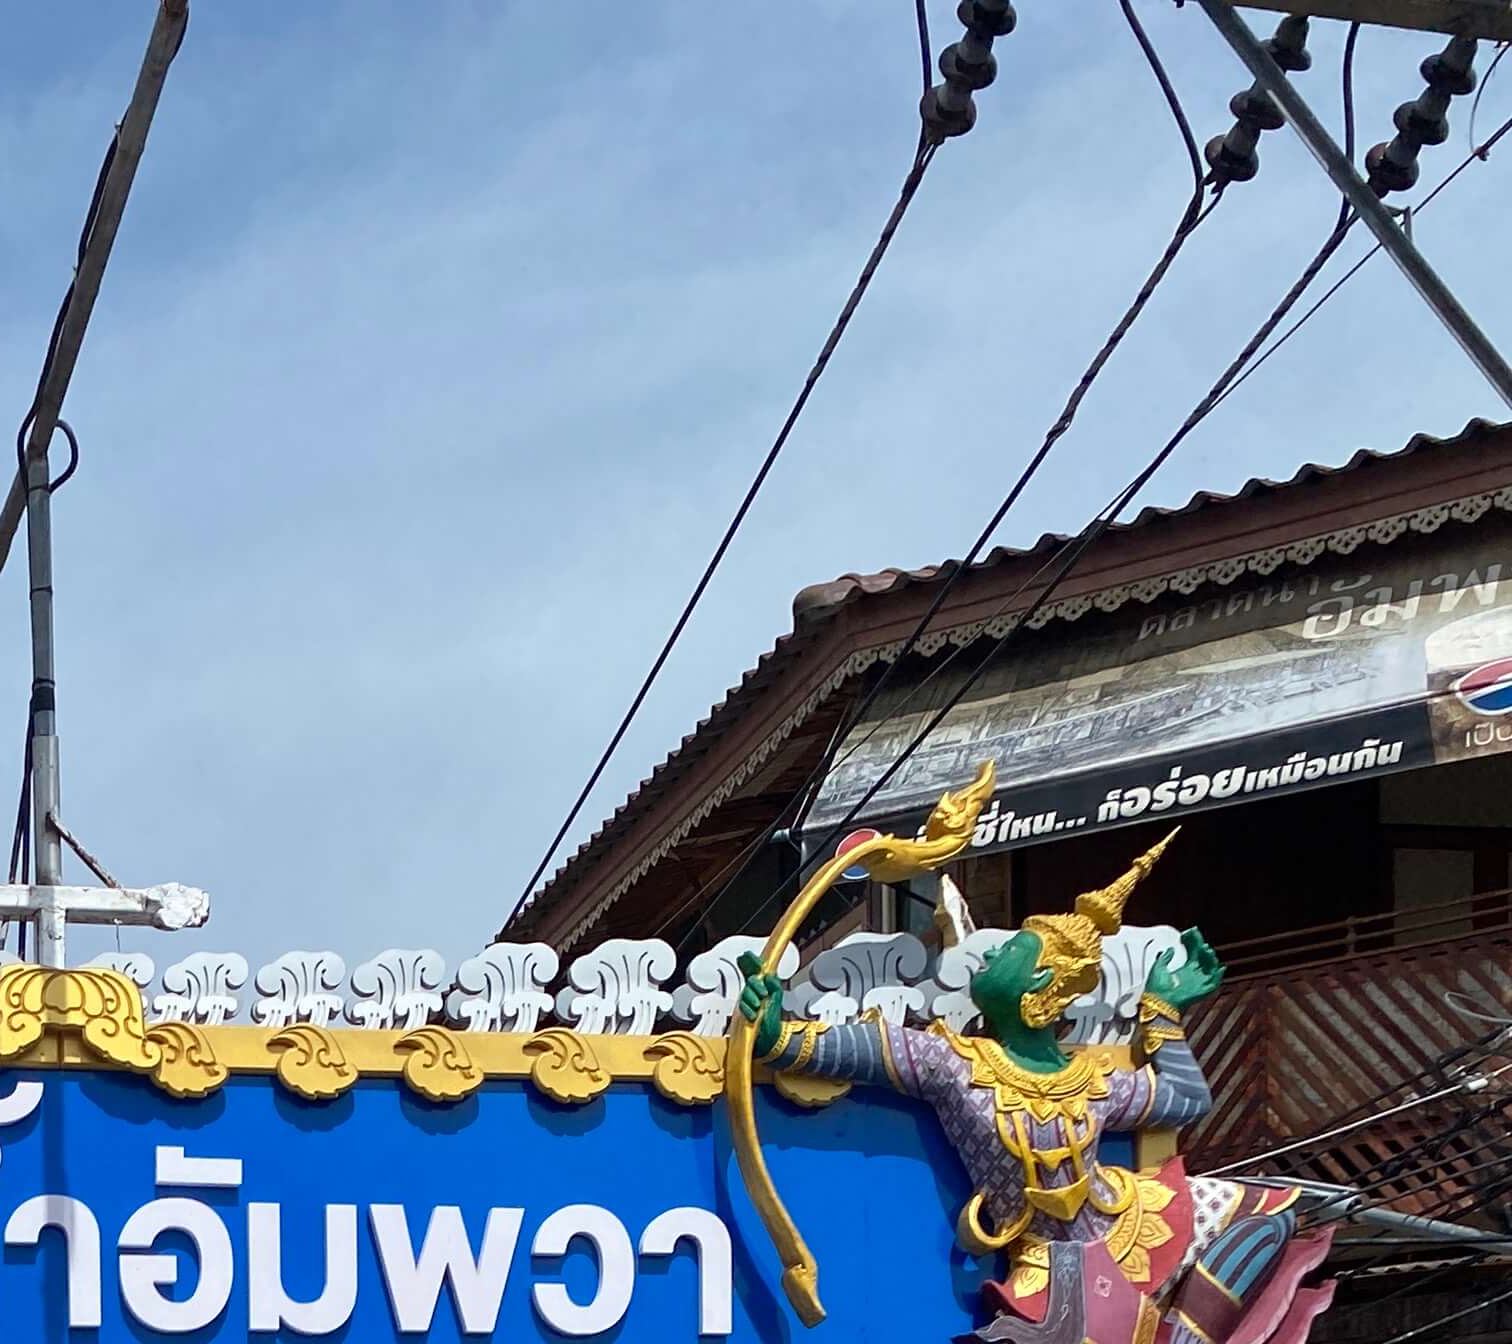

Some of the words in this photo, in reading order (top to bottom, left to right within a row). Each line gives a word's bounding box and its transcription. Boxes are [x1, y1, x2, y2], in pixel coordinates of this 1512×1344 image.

[1096, 738, 1405, 825] ก็อร่อยเหมือนกัน
